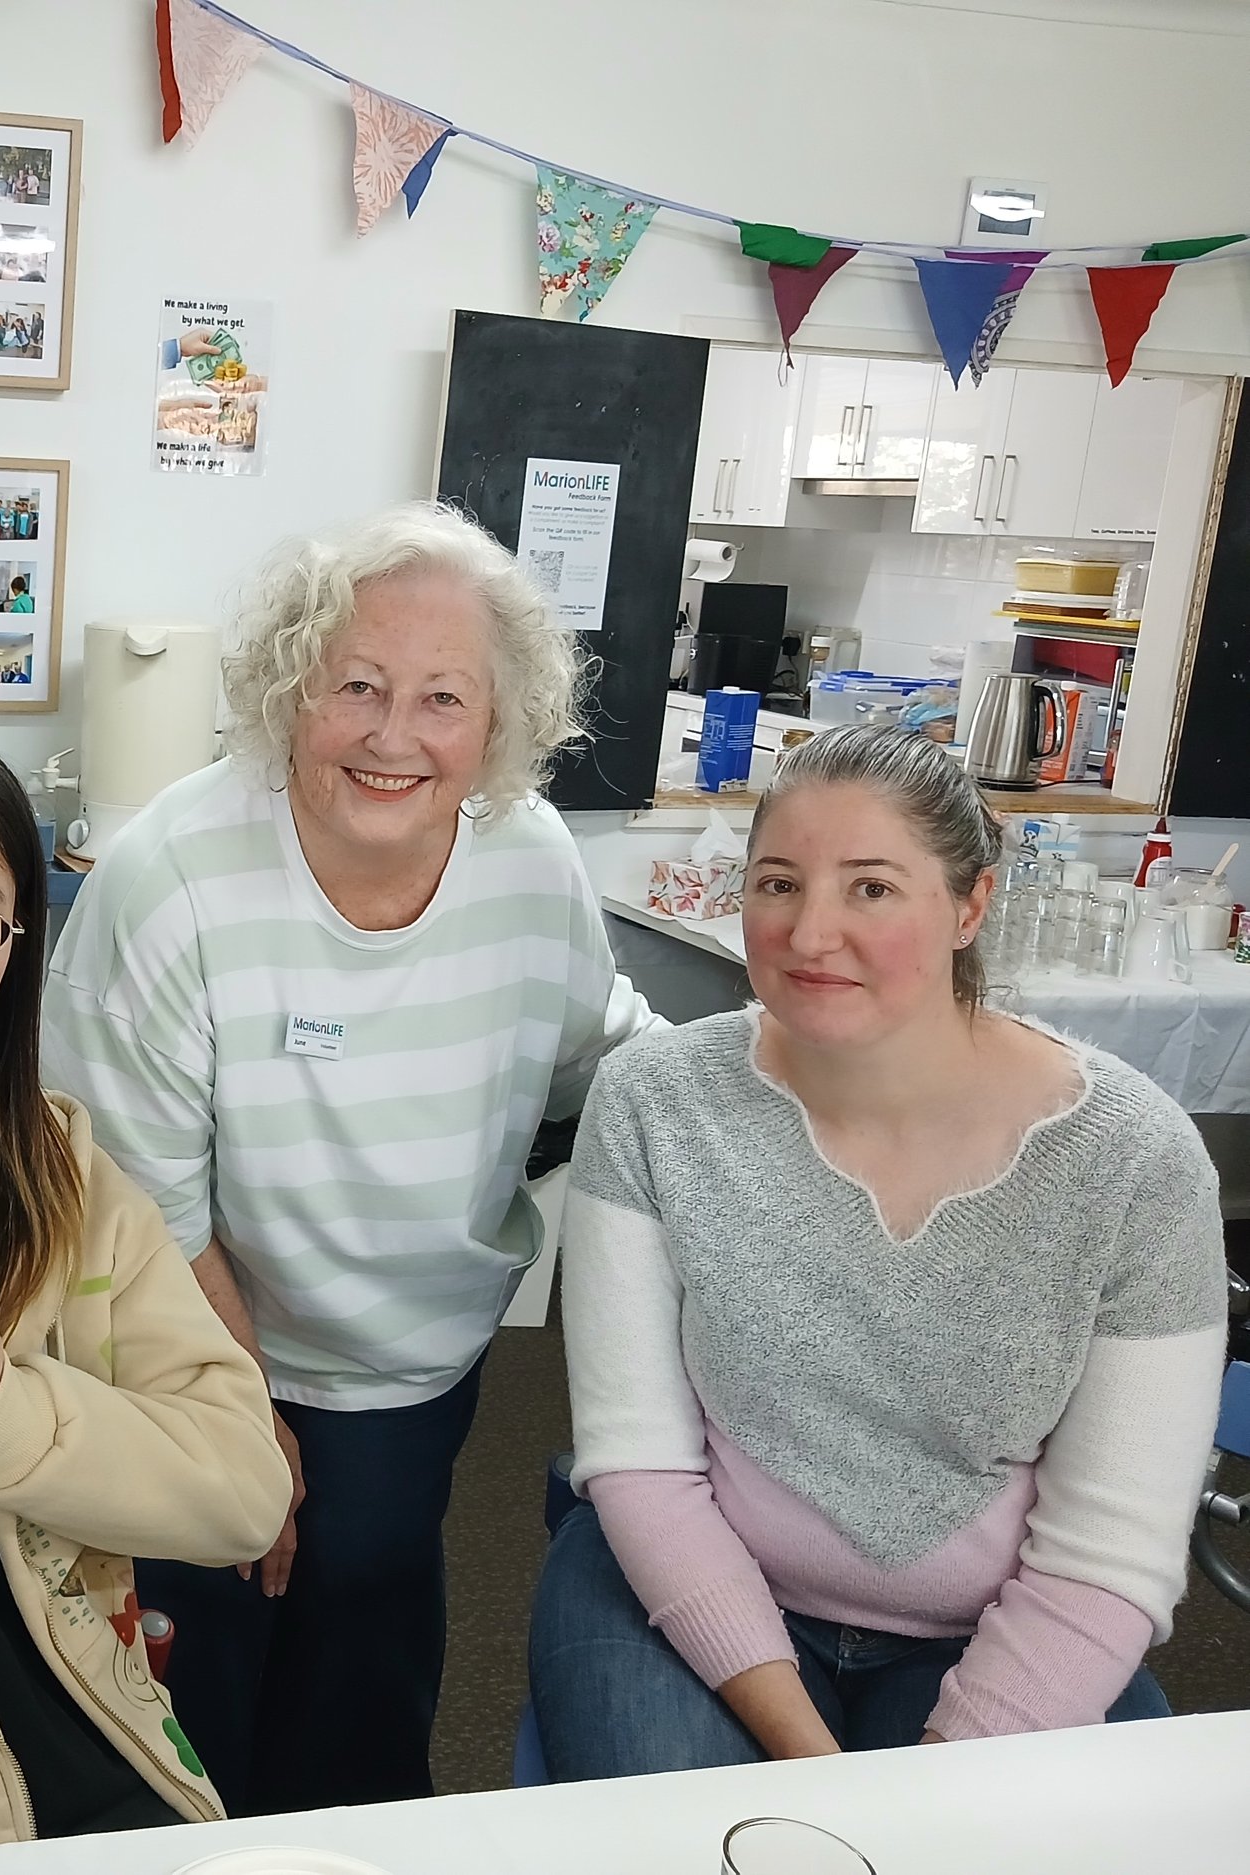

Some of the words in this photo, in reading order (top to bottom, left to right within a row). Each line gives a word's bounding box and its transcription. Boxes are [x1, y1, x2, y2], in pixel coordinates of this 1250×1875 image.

[164, 299, 175, 308] We
[177, 300, 197, 309] make
[199, 302, 205, 310] a
[206, 301, 228, 314] living
[182, 315, 192, 327] by
[194, 316, 215, 326] what
[217, 318, 228, 326] we
[157, 442, 167, 450] We
[198, 443, 211, 452] life
[534, 471, 610, 491] MarionLIFE
[568, 492, 596, 501] Feedback
[597, 494, 611, 502] Form
[293, 1016, 344, 1037] MarionLIFE
